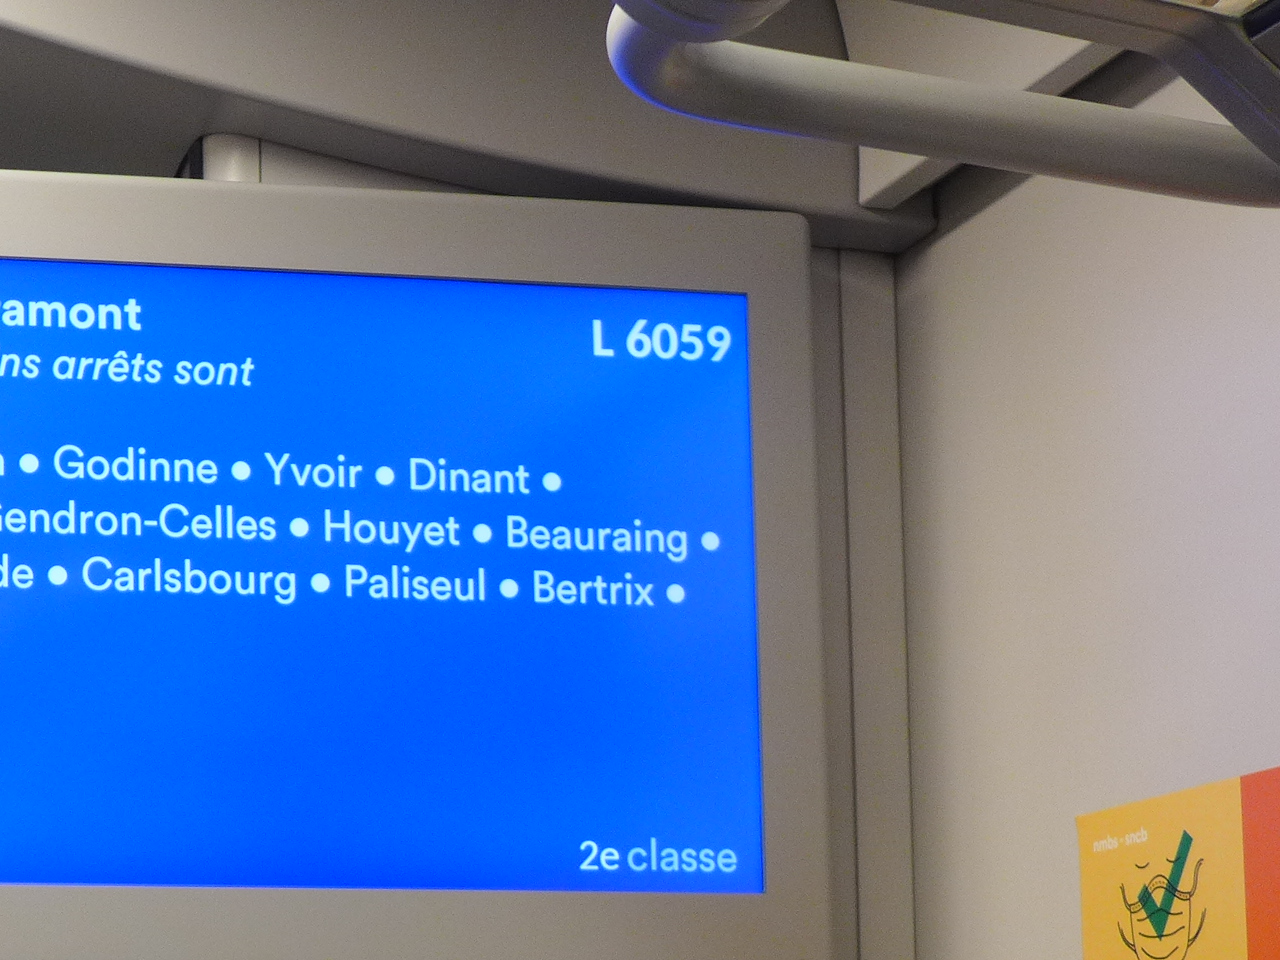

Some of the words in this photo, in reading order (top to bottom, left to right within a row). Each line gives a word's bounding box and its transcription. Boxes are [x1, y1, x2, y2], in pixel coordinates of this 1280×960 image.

[592, 319, 615, 357] L
[625, 319, 732, 362] 6059
[52, 350, 163, 383] arrêts
[173, 357, 255, 387] sont
[53, 444, 218, 484] Godinne
[264, 452, 362, 488] Yvoir
[409, 458, 530, 495] Dinant
[324, 509, 460, 553] Houyet
[507, 515, 688, 563] Beauraing
[82, 556, 296, 607] Carlsbourg
[345, 564, 486, 602] Paliseul
[533, 570, 655, 607] Bertrix
[579, 840, 619, 870] 2e
[627, 837, 738, 873] classe
[1093, 835, 1118, 852] nmbs
[1125, 826, 1148, 846] sncb
